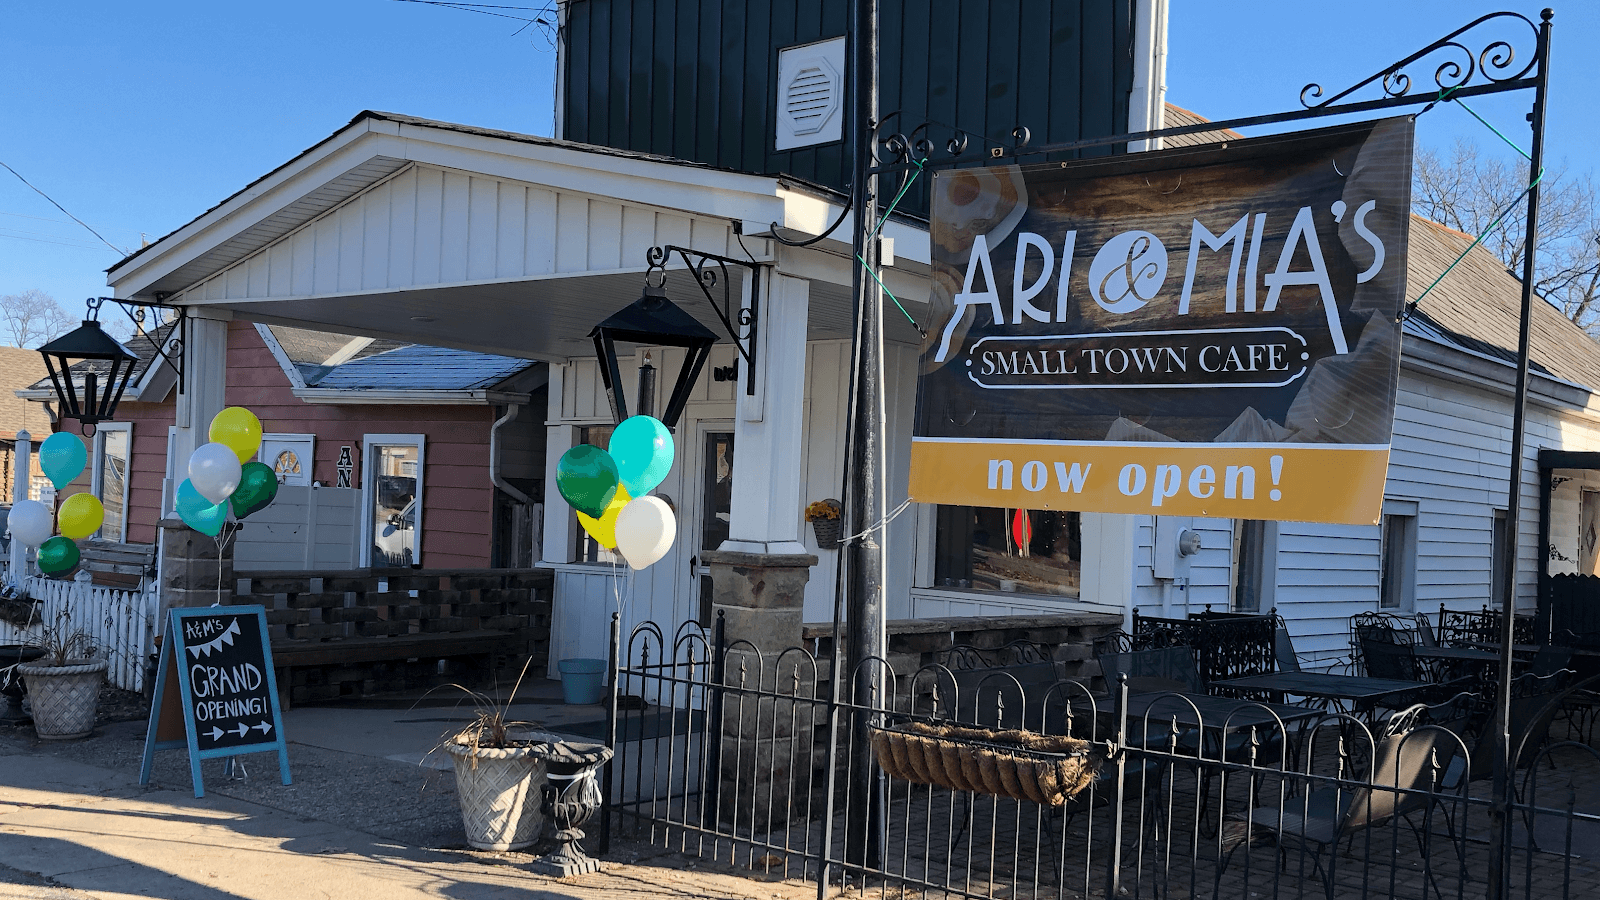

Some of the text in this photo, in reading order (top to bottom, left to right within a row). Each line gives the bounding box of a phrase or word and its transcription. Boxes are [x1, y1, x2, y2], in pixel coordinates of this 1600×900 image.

[934, 200, 1387, 363] ARI & MIA'S
[980, 343, 1290, 377] SMALL TOWN CAFE
[987, 455, 1285, 507] now open!
[191, 662, 262, 698] GRAND
